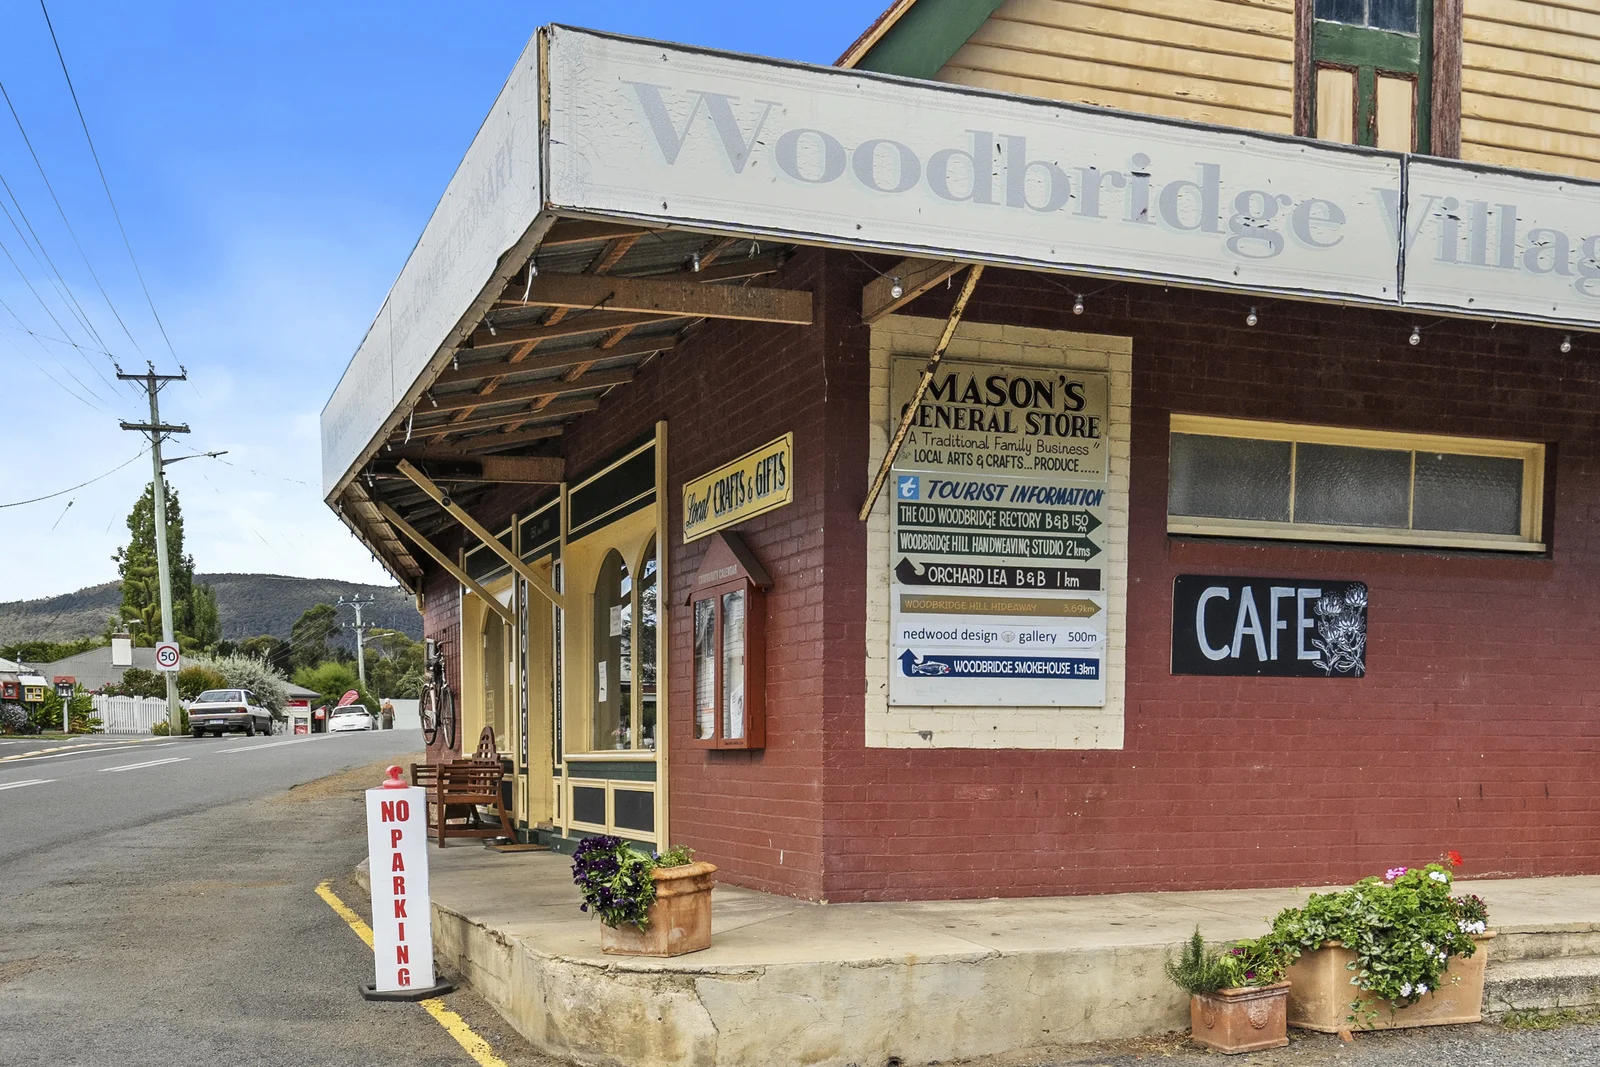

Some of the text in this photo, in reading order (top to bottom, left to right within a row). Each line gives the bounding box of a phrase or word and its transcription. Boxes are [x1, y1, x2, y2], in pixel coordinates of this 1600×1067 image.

[622, 80, 1347, 259] Woodbridge
[917, 370, 1087, 412] MASON'S
[1025, 411, 1101, 439] STORE
[908, 431, 917, 445] A
[922, 431, 989, 449] Traditional
[994, 436, 1032, 456] Family
[914, 449, 943, 464] LOCAL
[947, 452, 973, 466] ARTS
[976, 454, 984, 470] &
[686, 450, 786, 527] Local CRAFTS & GIFTS
[928, 480, 1105, 507] TOURIST INFORMATION
[900, 505, 917, 523] THE
[919, 506, 936, 524] OLD
[937, 507, 996, 527] WOODBRIDGE
[1000, 511, 1041, 529] RECTORY
[1071, 514, 1089, 526] 150
[900, 532, 950, 552] WOODBRIDGE
[952, 534, 969, 552] HILL
[972, 535, 1030, 557] HANDWEAVING
[1032, 538, 1064, 556] STUDIO
[928, 566, 984, 584] ORCHARD
[988, 569, 1008, 586] LEA
[1064, 571, 1080, 587] km
[904, 600, 1095, 613] WOODBRIDGE HILL HIDEAWAY 3.69km
[1196, 586, 1321, 661] CAFE
[903, 628, 1097, 645] nedwood design gallery 500m
[161, 651, 176, 662] 50
[953, 660, 1096, 676] WOODBRIDGE SMOKEHOUSE 1.3km
[381, 799, 410, 823] NO
[391, 828, 411, 988] PARKING
